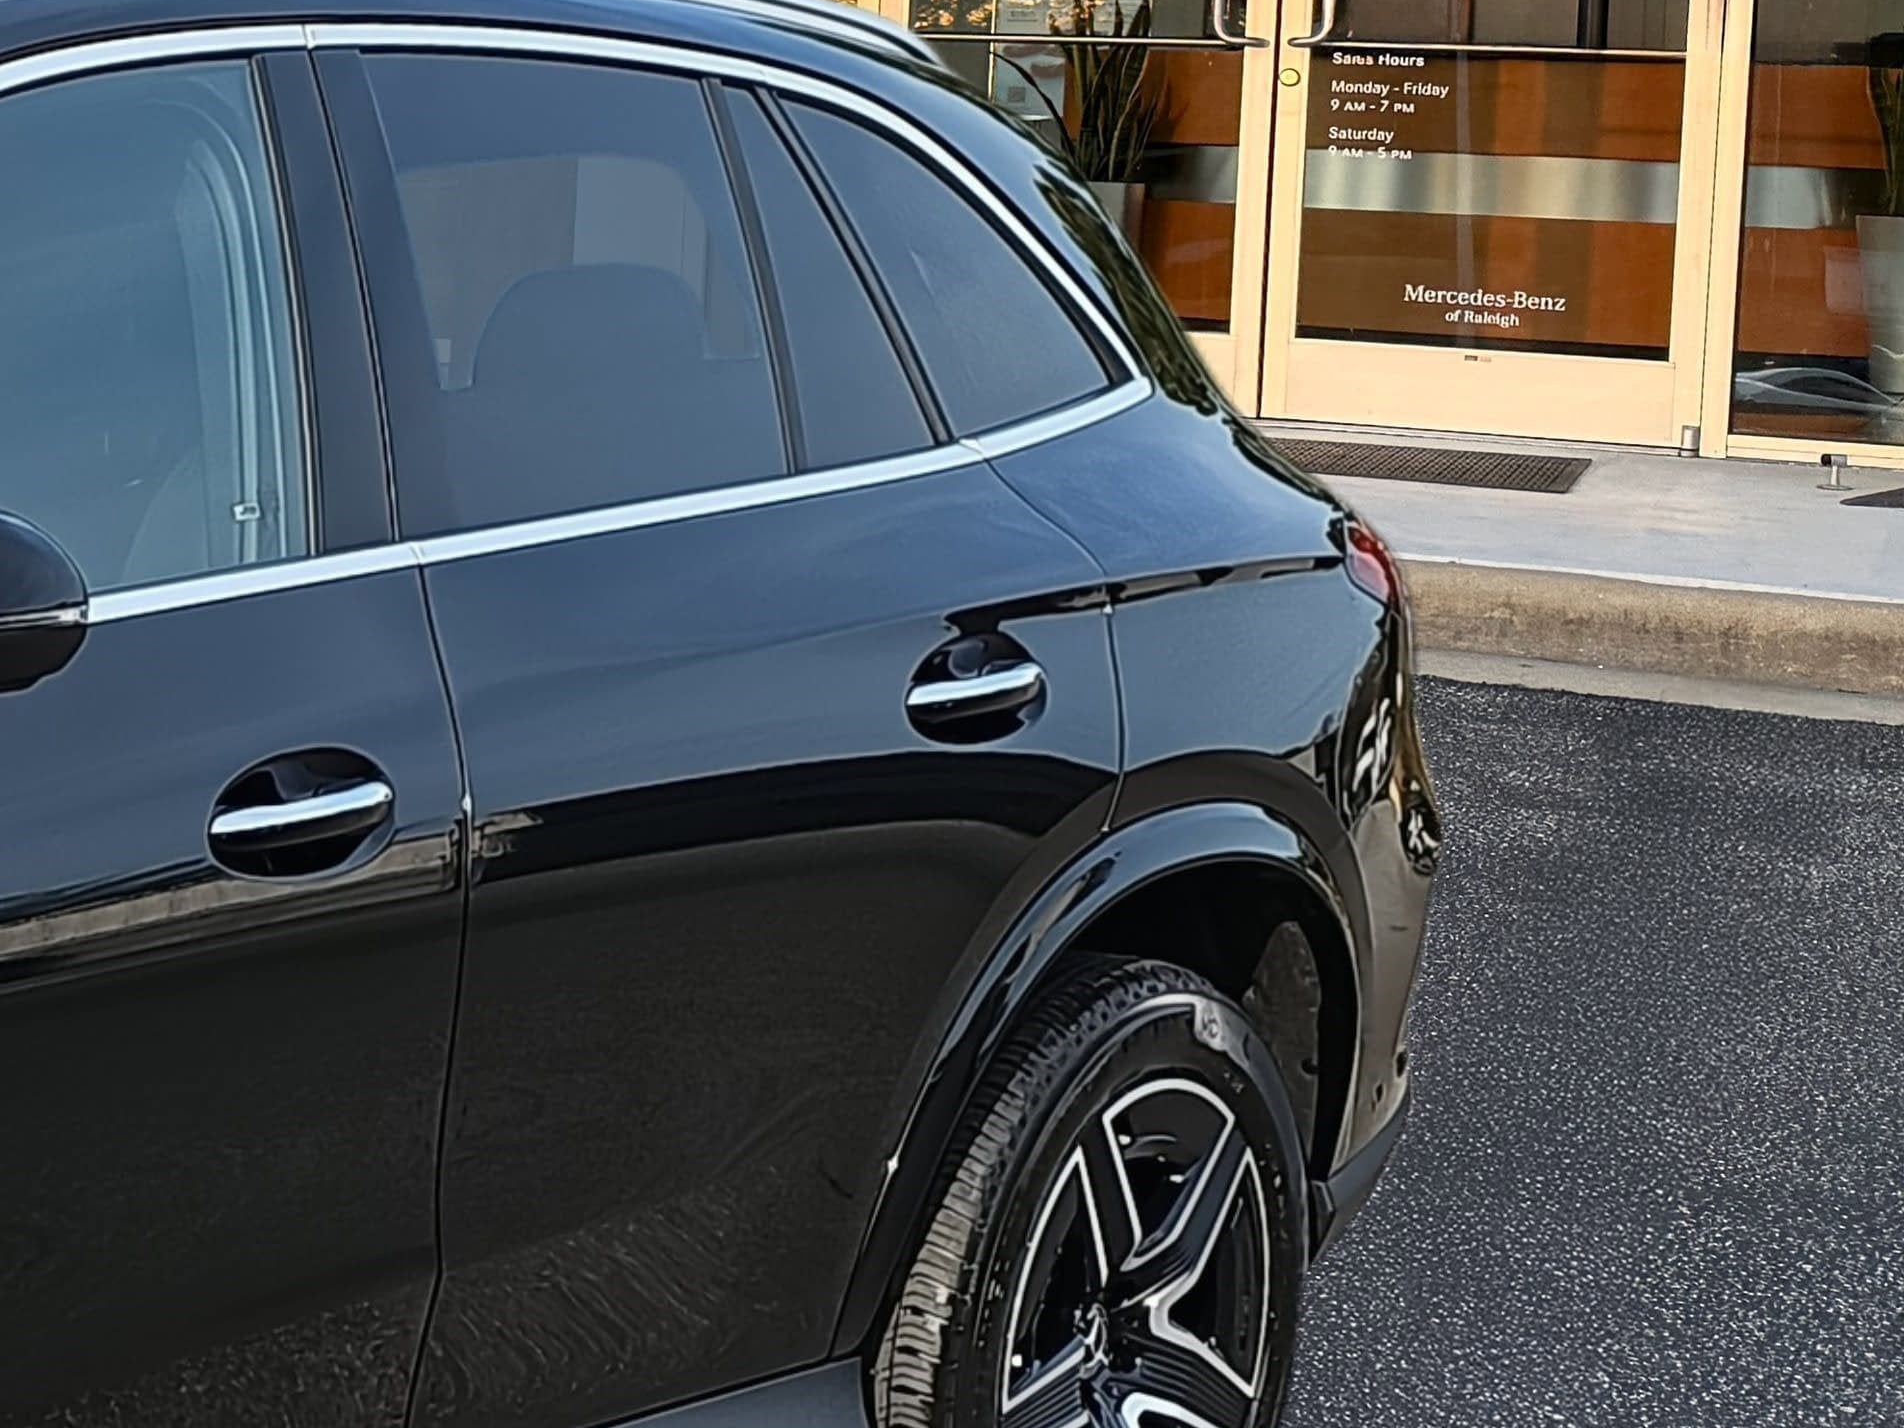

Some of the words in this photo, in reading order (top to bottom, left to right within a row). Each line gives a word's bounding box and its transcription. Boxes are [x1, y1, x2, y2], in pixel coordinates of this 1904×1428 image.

[1378, 53, 1425, 67] Hours
[1331, 80, 1390, 97] Monday
[1403, 82, 1449, 99] Friday
[1330, 99, 1340, 111] 9
[1344, 102, 1366, 111] AM
[1380, 100, 1390, 112] 7
[1394, 103, 1415, 113] PM
[1328, 126, 1394, 144] Saturday
[1328, 145, 1337, 157] 9
[1378, 147, 1387, 158] 5
[1404, 284, 1566, 311] Mercedes-Benz
[1445, 310, 1459, 322] of
[1464, 311, 1520, 329] Raleigh
